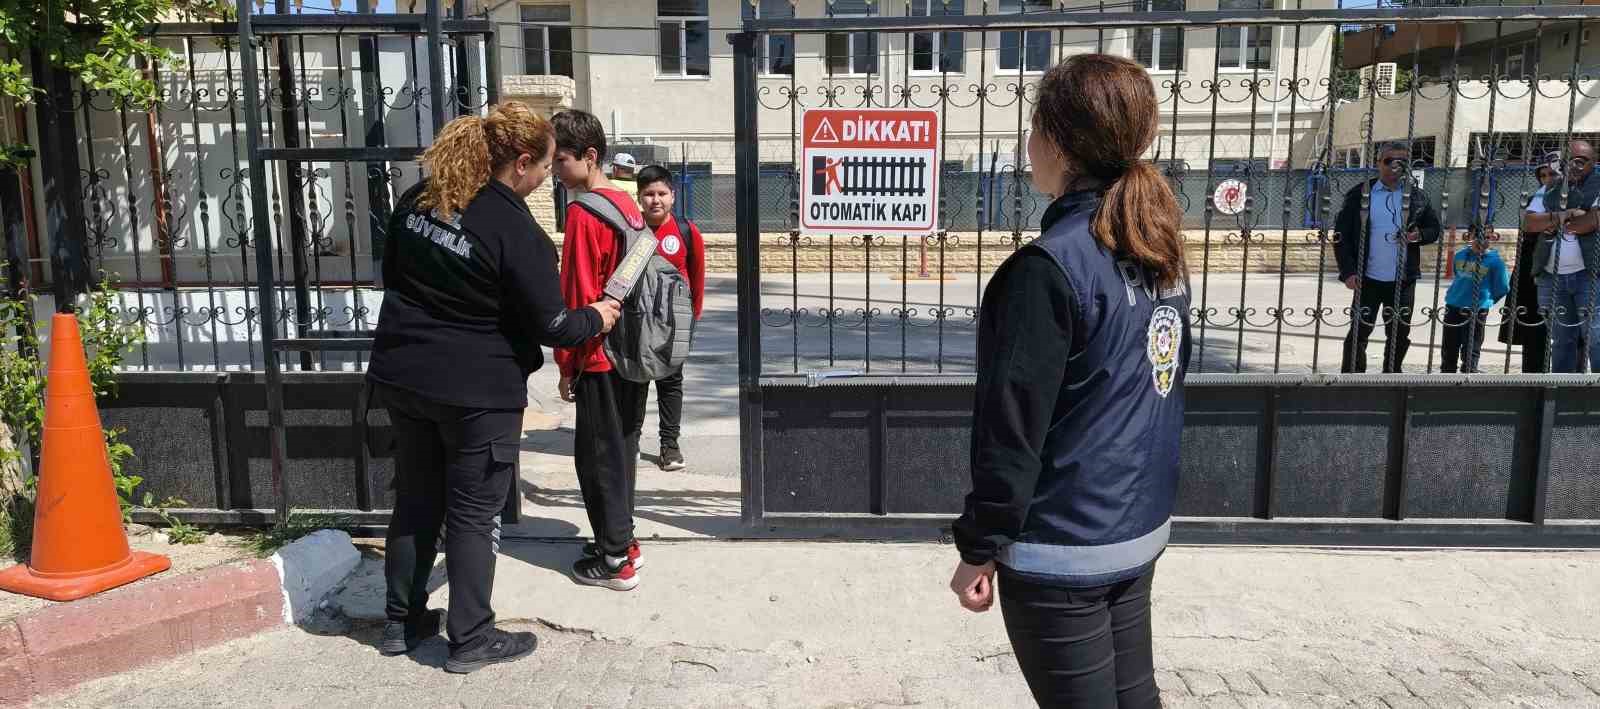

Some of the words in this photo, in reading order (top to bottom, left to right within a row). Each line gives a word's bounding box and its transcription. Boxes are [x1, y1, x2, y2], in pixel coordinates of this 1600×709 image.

[842, 115, 930, 142] DİKKAT!
[810, 198, 887, 221] OTOMATİK
[891, 203, 926, 222] KAPI
[406, 213, 472, 258] GÜVENLİK
